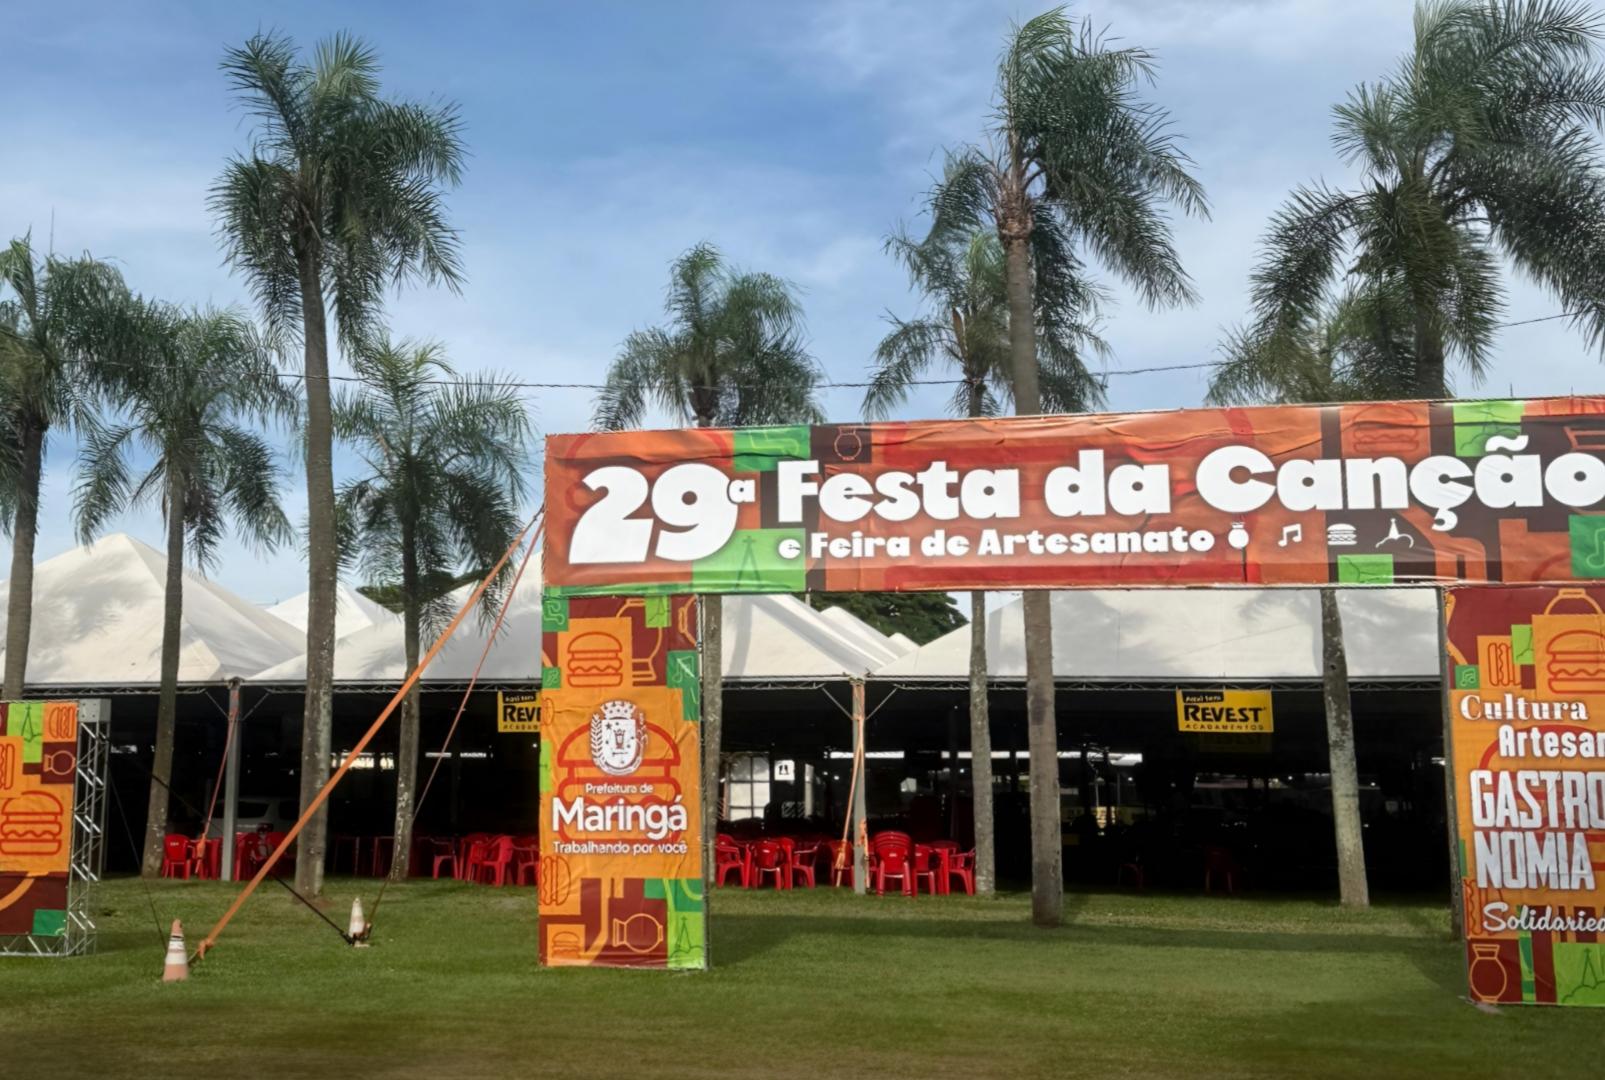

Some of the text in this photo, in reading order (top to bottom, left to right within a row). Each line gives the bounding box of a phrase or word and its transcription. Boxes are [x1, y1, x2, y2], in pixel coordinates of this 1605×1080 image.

[777, 459, 1021, 523] Festa
[1044, 448, 1172, 517] da
[1196, 434, 1605, 532] Canção
[778, 526, 1216, 560] e Feira de Artesanato
[1183, 704, 1263, 722] REVEST
[1460, 692, 1589, 721] Cultura
[585, 783, 653, 794] Prefeitura de
[1470, 769, 1605, 829] GASTRO
[552, 794, 688, 840] Maringá
[553, 840, 688, 856] Trabalhando por você
[1473, 830, 1596, 890] NOMIA
